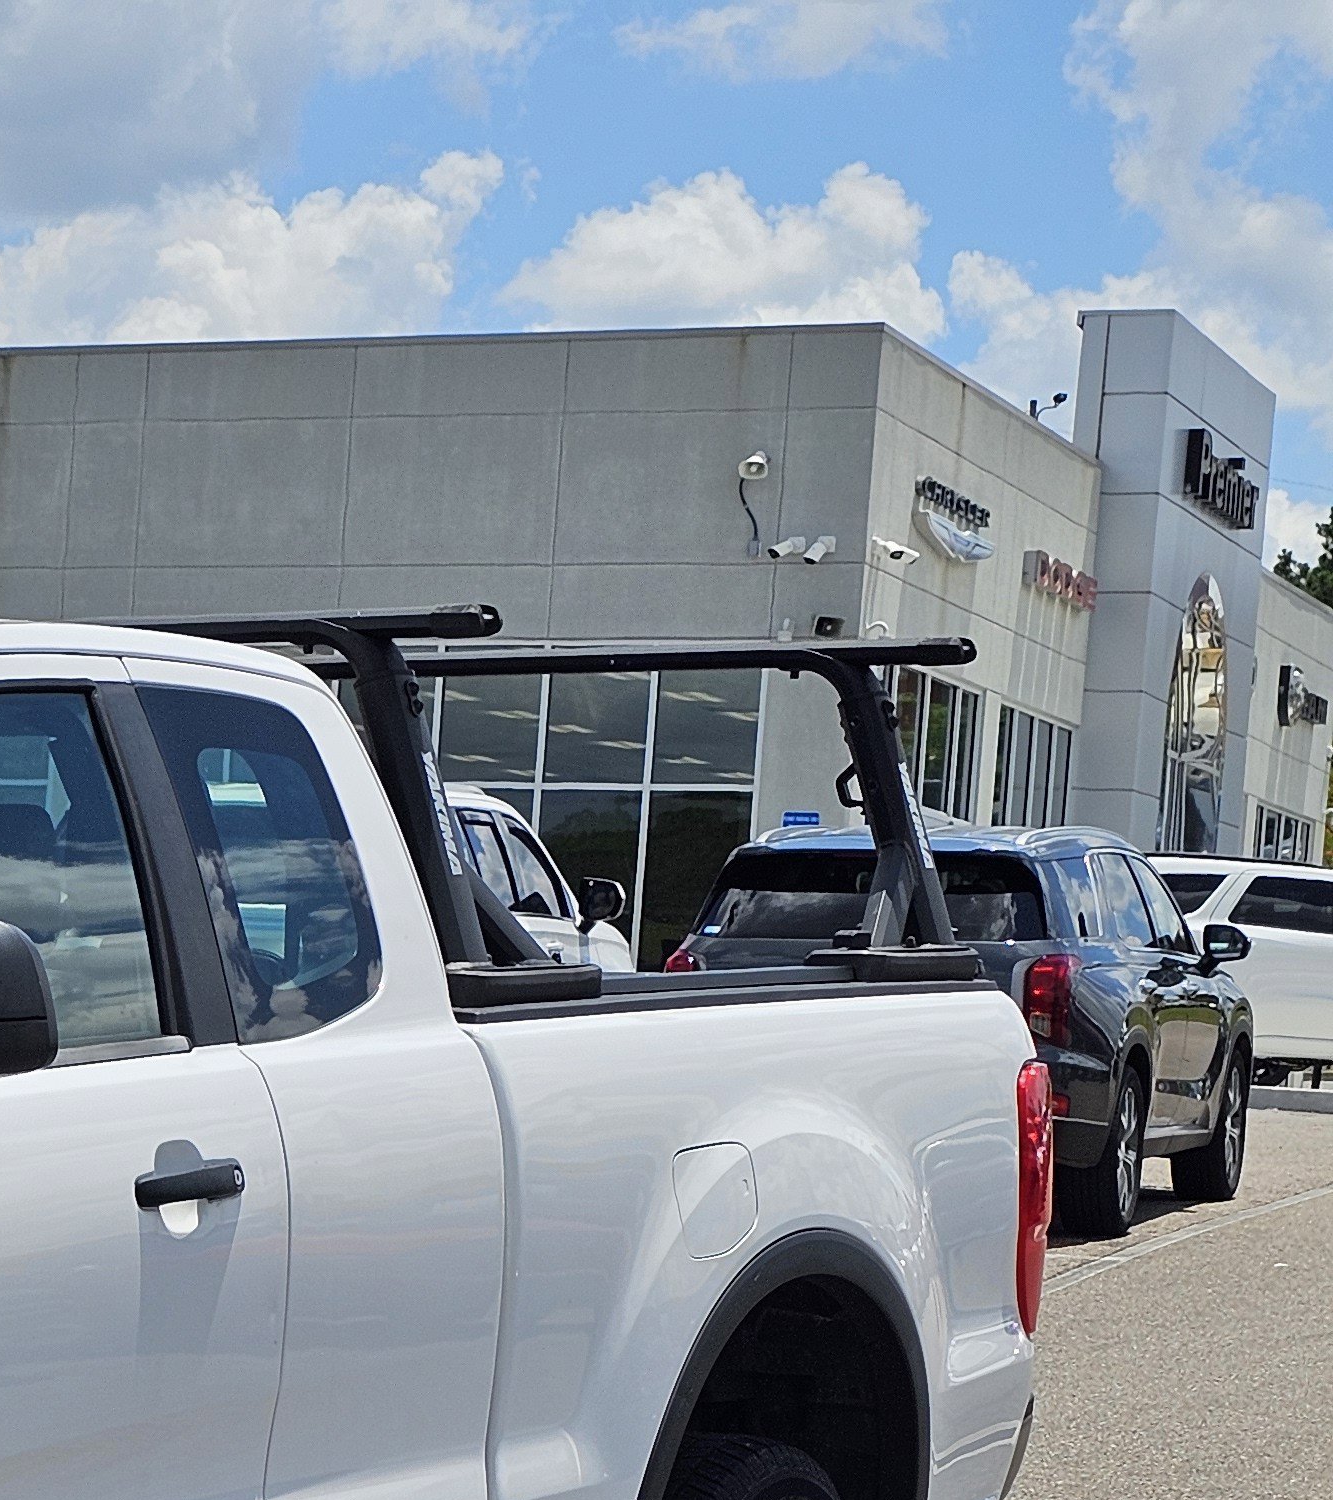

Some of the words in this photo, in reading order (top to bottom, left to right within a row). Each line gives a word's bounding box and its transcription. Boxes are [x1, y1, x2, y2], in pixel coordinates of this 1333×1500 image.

[916, 476, 990, 528] CHRYSLER
[1185, 428, 1260, 529] Premier
[1023, 550, 1097, 612] DODGE
[421, 751, 463, 876] YAKIMA
[897, 761, 934, 869] YAKIMA
